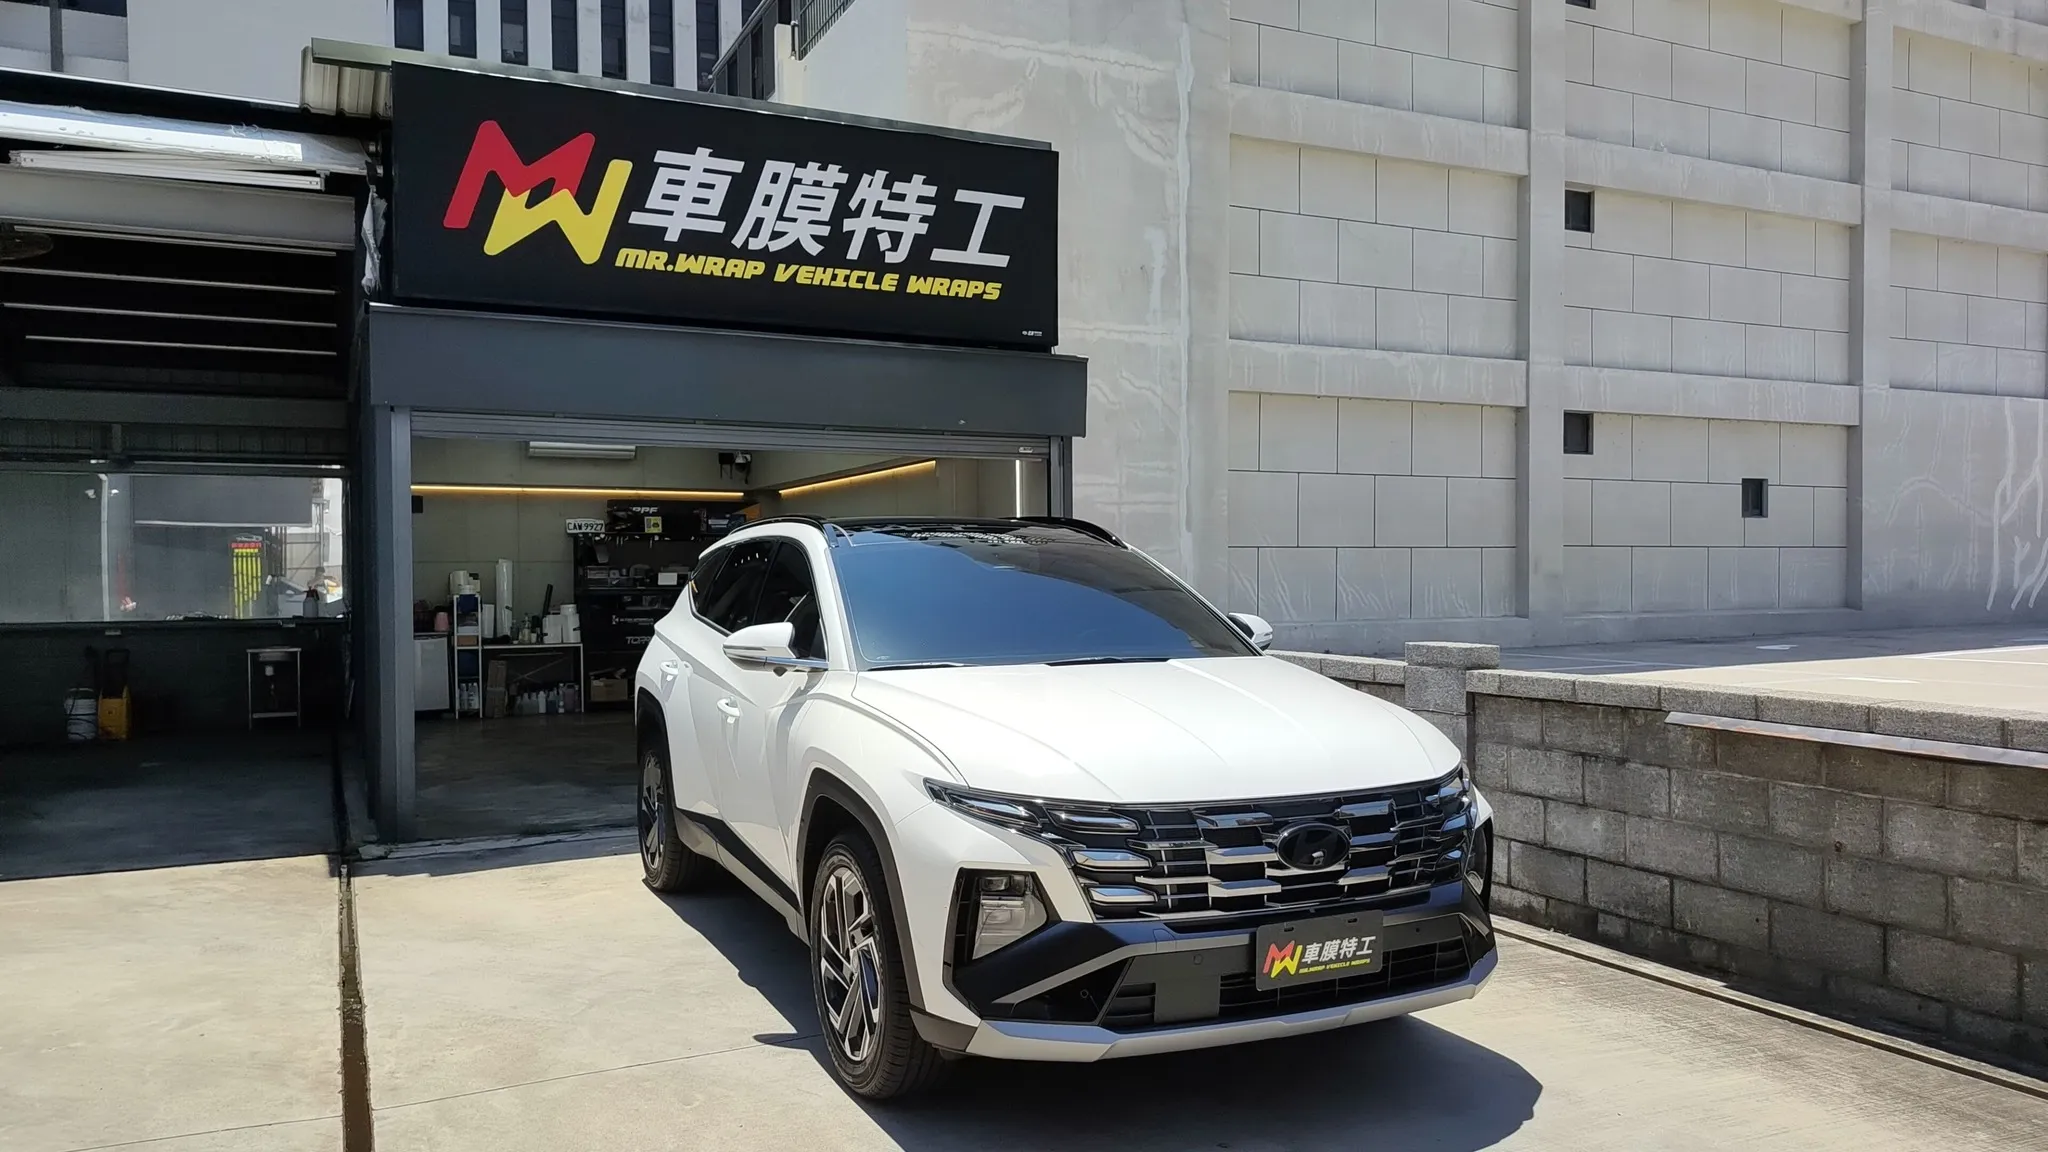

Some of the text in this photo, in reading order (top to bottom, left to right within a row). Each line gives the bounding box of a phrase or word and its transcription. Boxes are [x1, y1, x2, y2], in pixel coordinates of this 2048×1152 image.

[628, 146, 1025, 268] 車膜特工
[615, 247, 1003, 300] MR.WRAP VEHICLE WRAPS
[1301, 935, 1376, 964] 車膜特工
